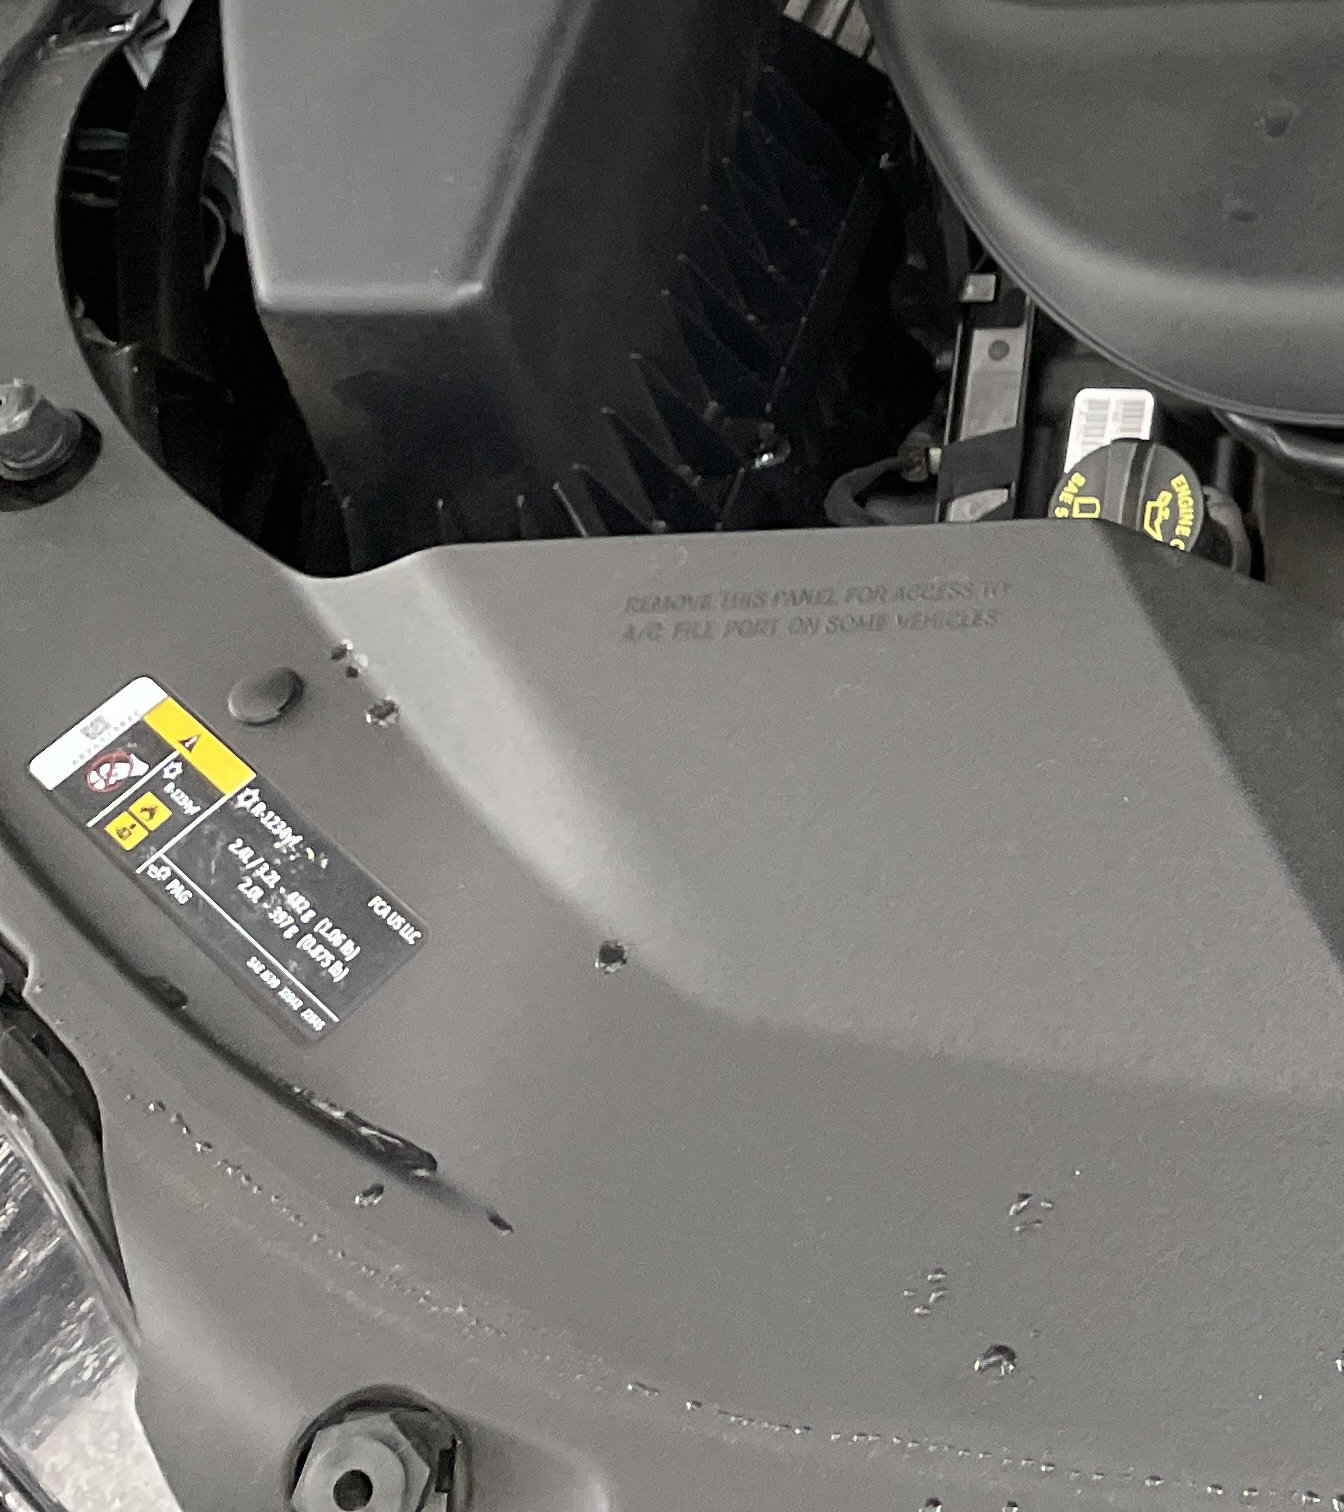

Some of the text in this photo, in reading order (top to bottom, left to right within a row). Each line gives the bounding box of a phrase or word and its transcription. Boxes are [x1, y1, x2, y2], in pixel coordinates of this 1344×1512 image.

[1171, 474, 1194, 537] ENGINE
[624, 577, 1012, 615] REMOVE THIS PANEL FOR ACCESS TO
[620, 607, 999, 643] A/C FILL PORT ON SOME VEHICLES
[165, 879, 192, 905] PAG
[368, 896, 421, 944] FCA US LLC
